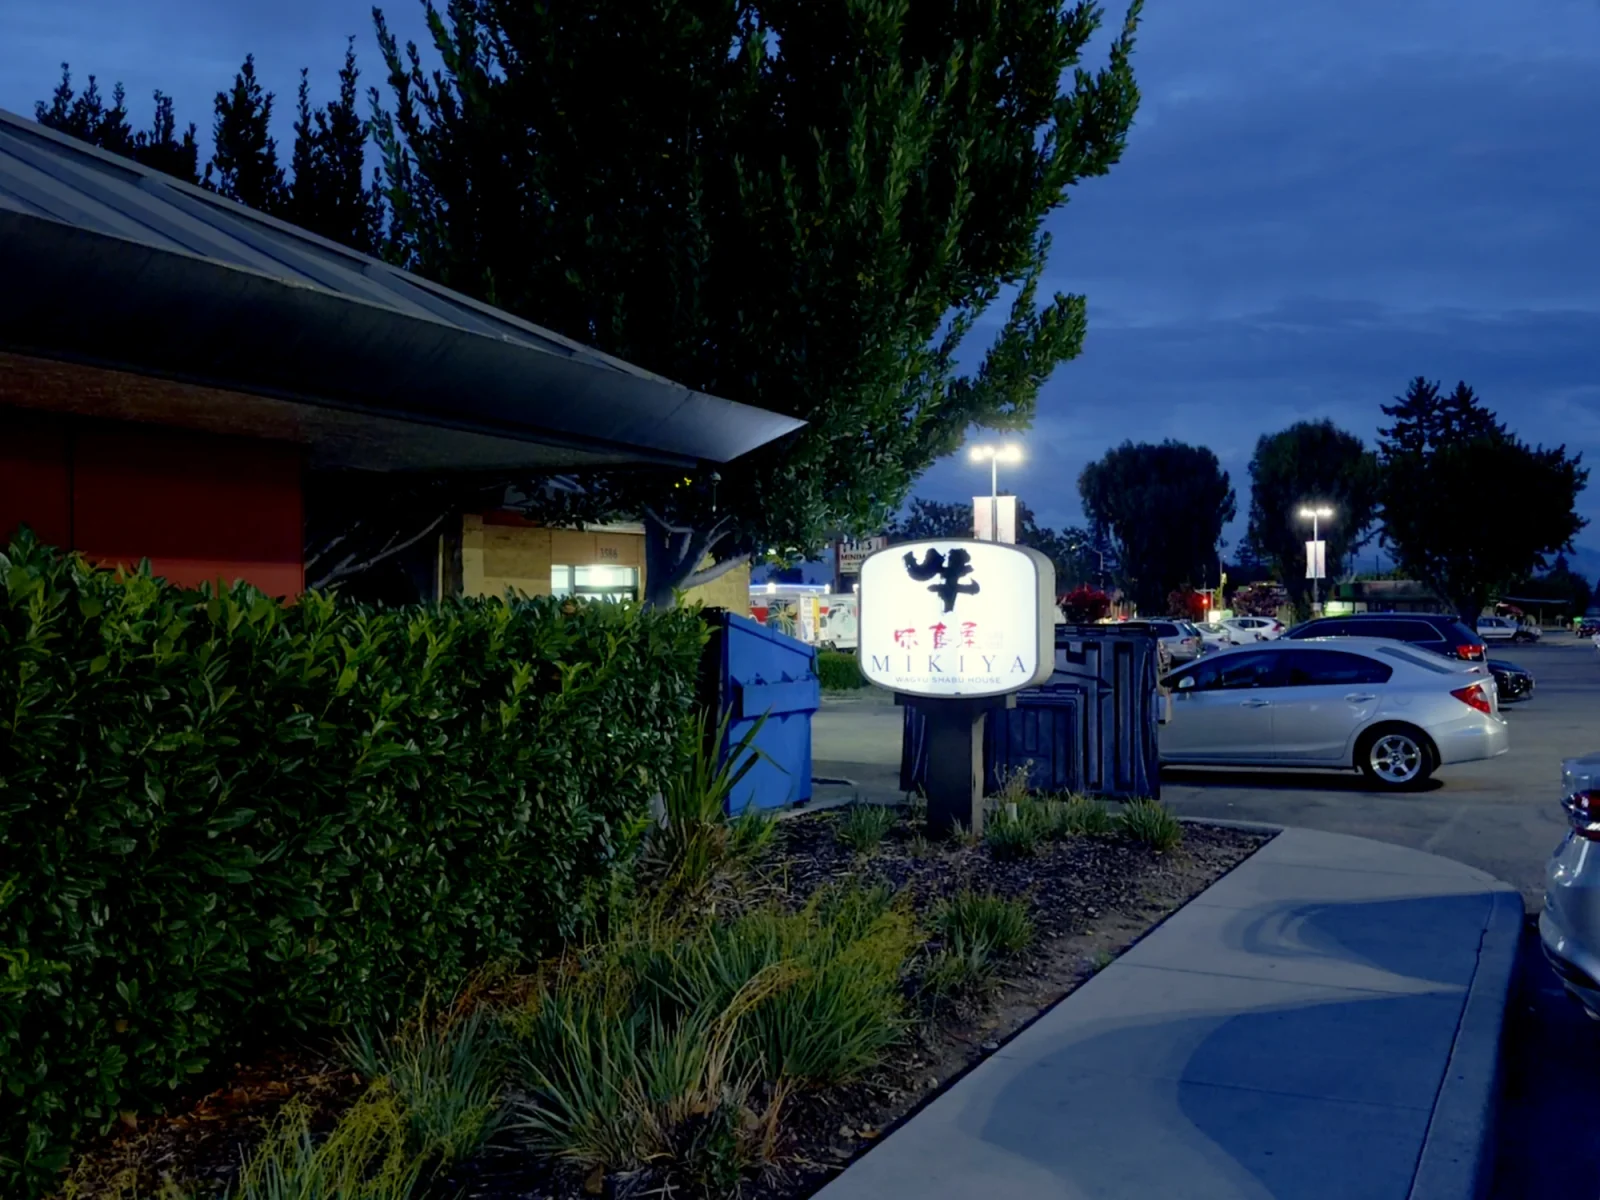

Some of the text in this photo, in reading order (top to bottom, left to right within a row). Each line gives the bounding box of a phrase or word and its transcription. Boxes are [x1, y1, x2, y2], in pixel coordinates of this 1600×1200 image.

[871, 655, 1027, 673] MIKIYA
[895, 676, 1002, 684] WAGYU SHABU HOUSE
